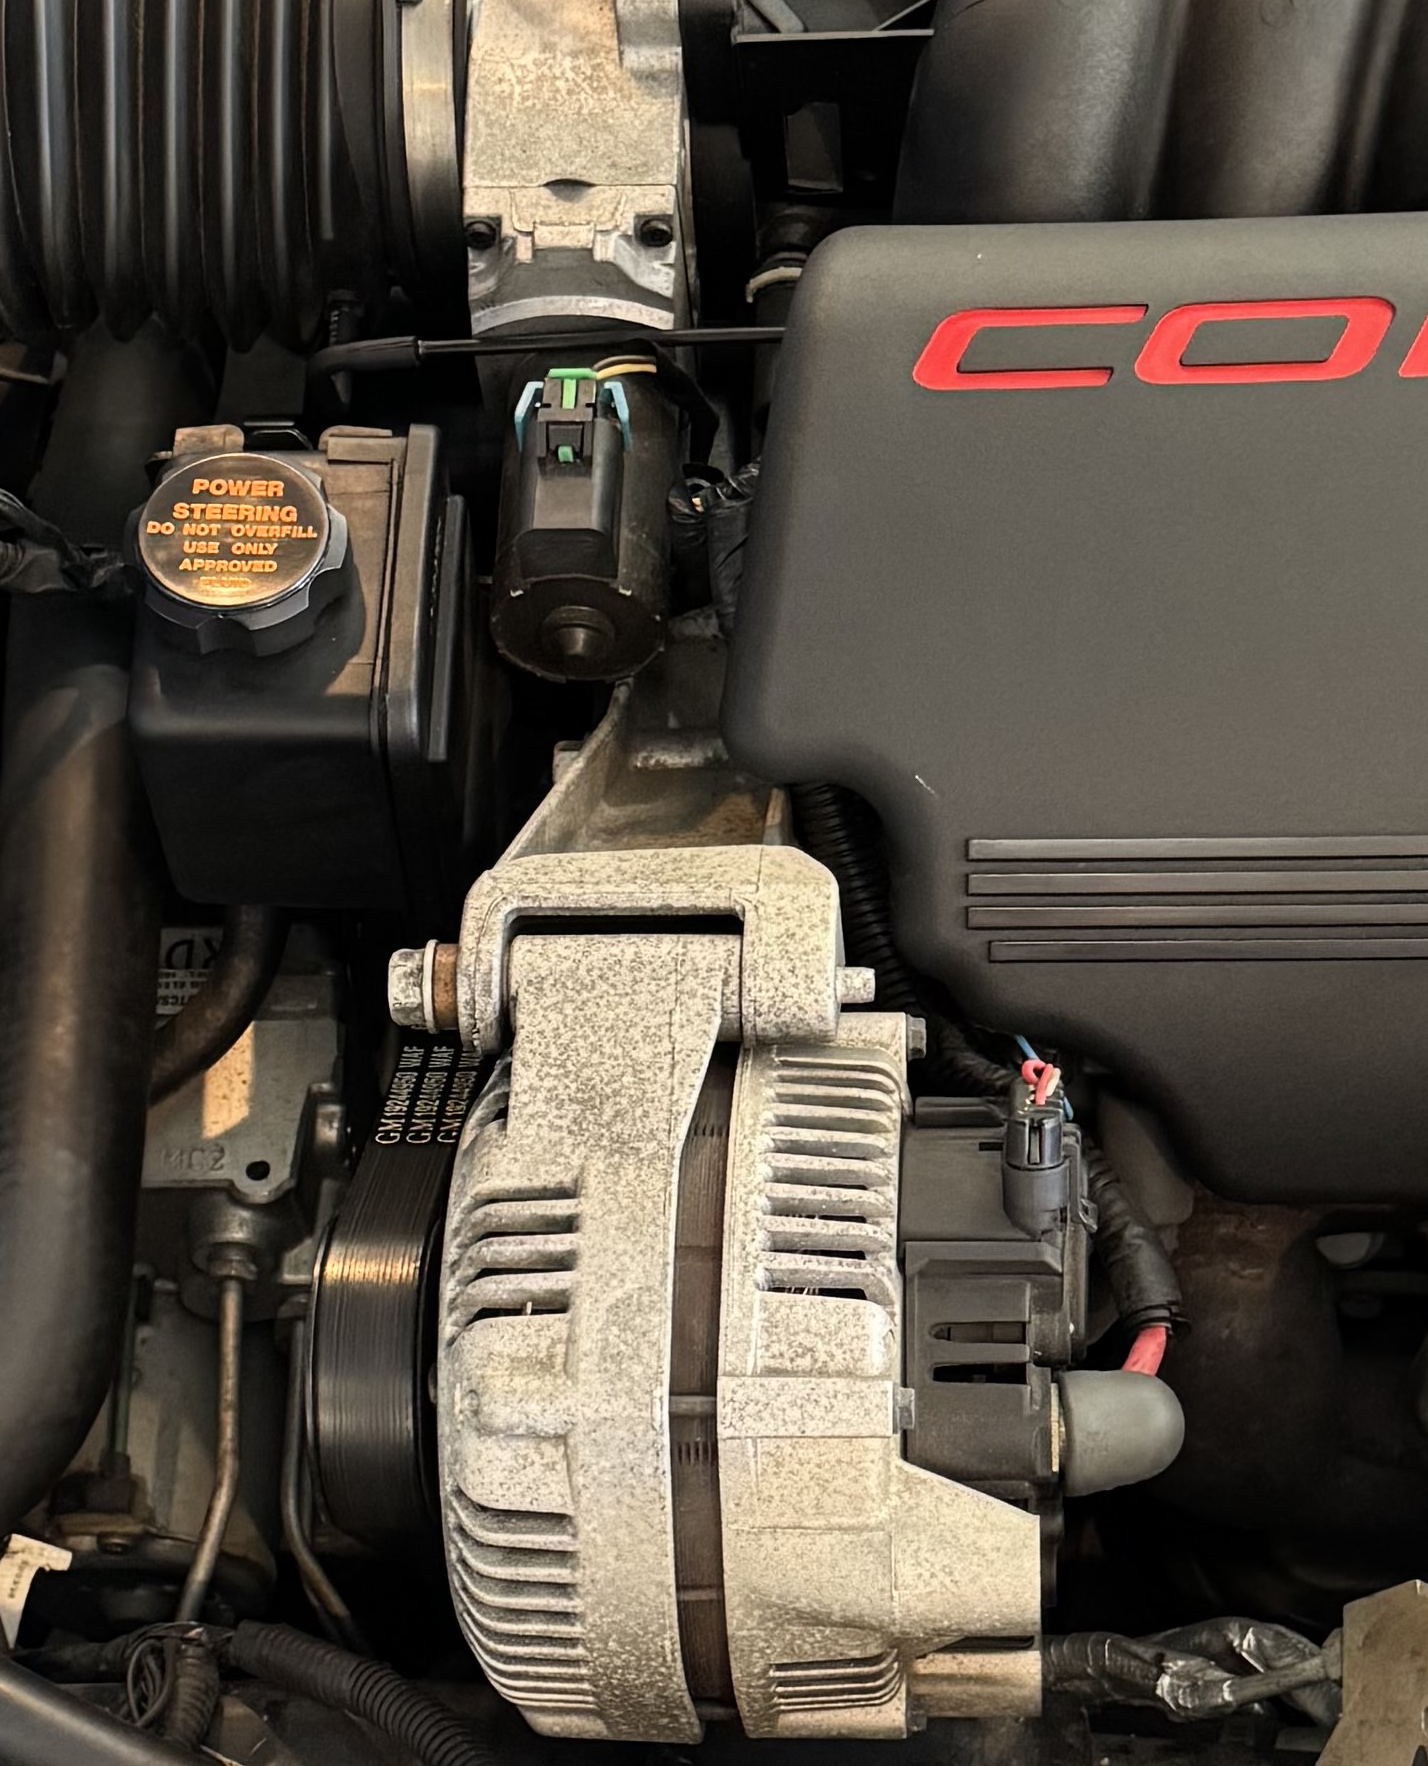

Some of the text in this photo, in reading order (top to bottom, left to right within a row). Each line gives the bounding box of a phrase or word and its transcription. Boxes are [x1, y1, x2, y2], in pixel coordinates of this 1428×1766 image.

[192, 478, 285, 497] POWER
[173, 503, 298, 522] STEERING
[146, 521, 318, 539] DO NOT OVERFILL
[183, 541, 278, 555] USE ONLY
[179, 559, 277, 572] APPROVED
